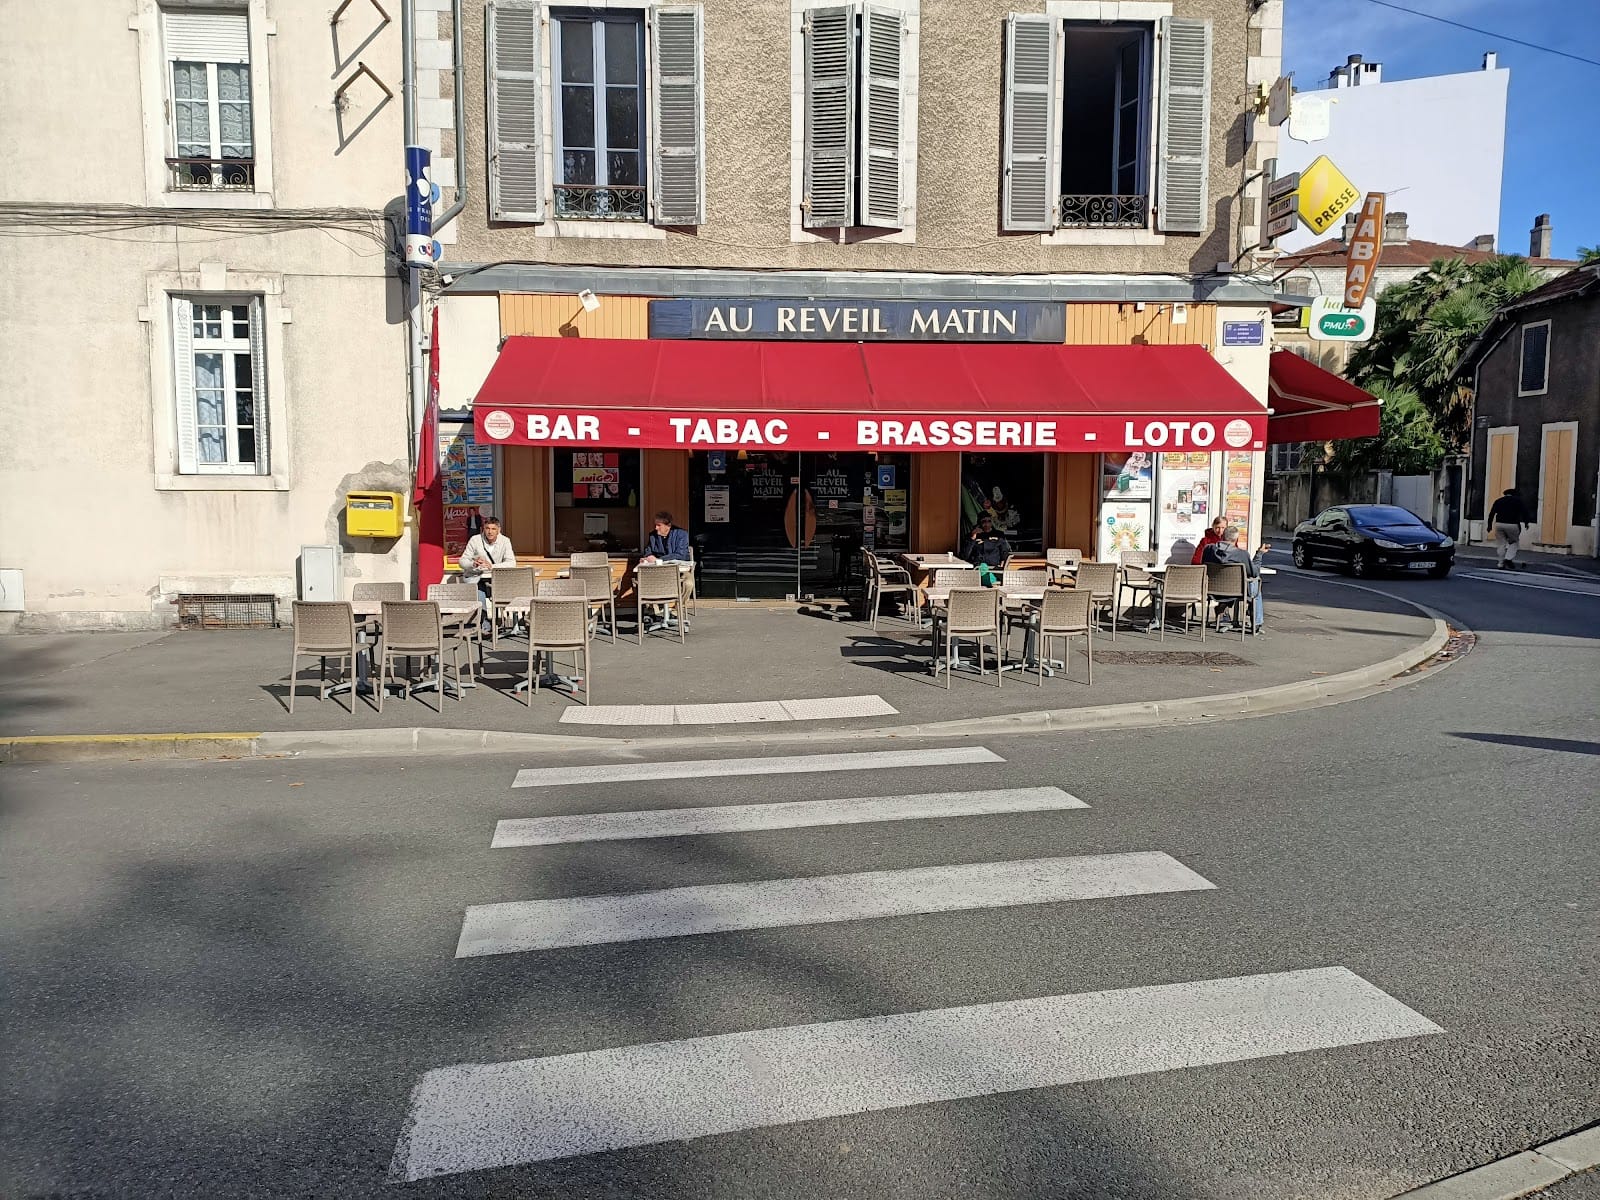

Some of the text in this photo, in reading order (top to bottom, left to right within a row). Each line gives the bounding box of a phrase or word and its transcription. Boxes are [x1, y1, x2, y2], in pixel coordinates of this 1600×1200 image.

[1315, 188, 1355, 229] PRESSE
[1345, 196, 1380, 304] TABAC
[703, 306, 1017, 335] AU REVEIL MATIN
[1323, 321, 1346, 330] PMU
[526, 413, 600, 441] BAR
[669, 418, 789, 445] TABAC
[857, 420, 1057, 446] BRASSERIE
[1124, 421, 1216, 447] LOTO
[827, 469, 840, 477] AU
[752, 478, 783, 486] REVEIL
[817, 478, 848, 486] REVEIL
[753, 487, 784, 495] MATIN
[817, 487, 848, 495] MATIN
[444, 507, 469, 520] Maxi
